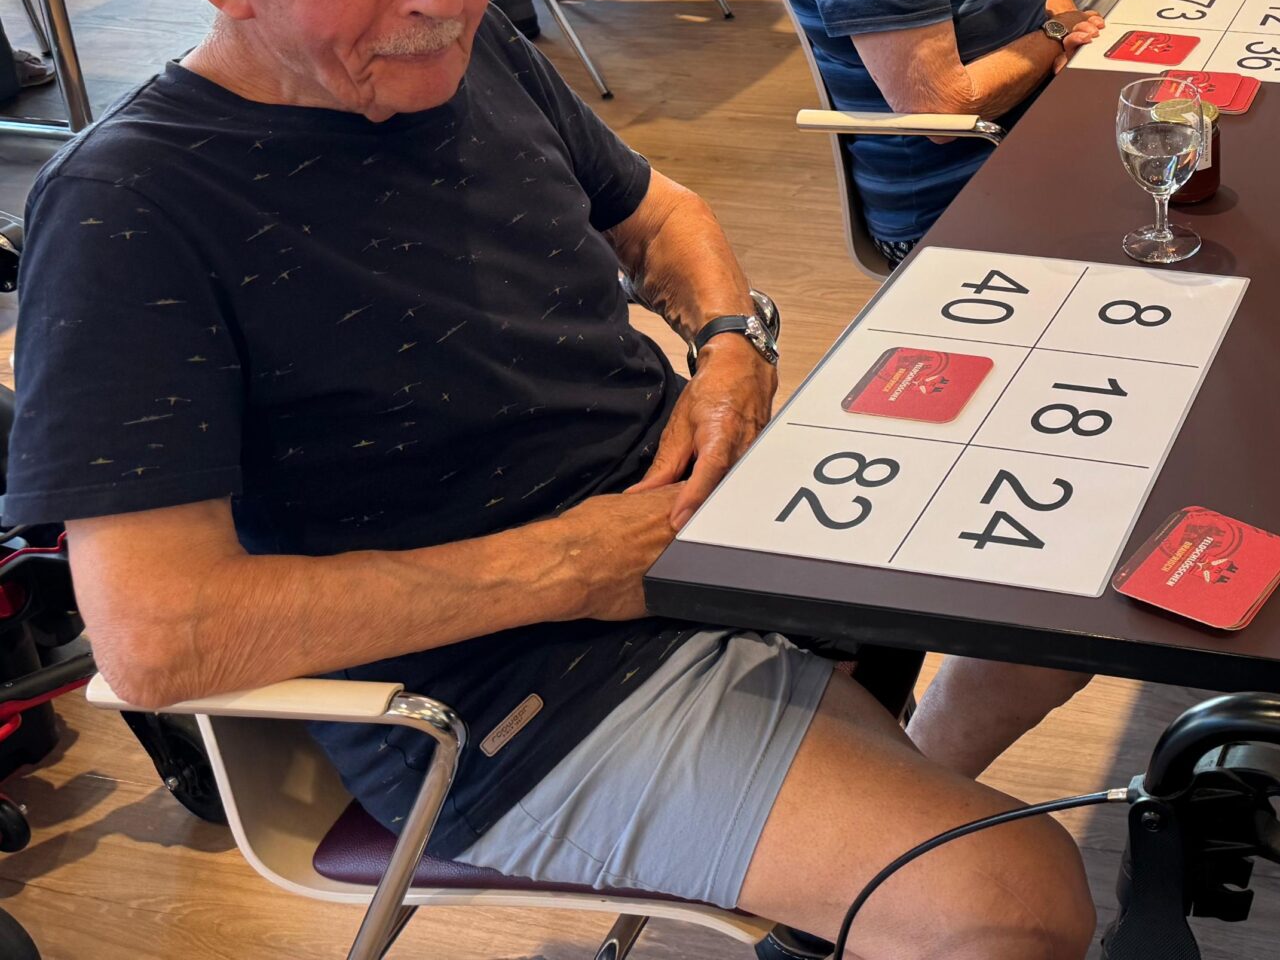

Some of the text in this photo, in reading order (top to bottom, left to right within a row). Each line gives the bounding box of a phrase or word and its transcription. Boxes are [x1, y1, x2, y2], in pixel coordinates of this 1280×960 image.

[941, 269, 1030, 326] 40
[1098, 299, 1171, 327] 8
[1030, 377, 1128, 437] 18
[774, 451, 900, 530] 82
[958, 469, 1075, 550] 24
[1166, 536, 1214, 587] FELDSCHLÖSSCHEN
